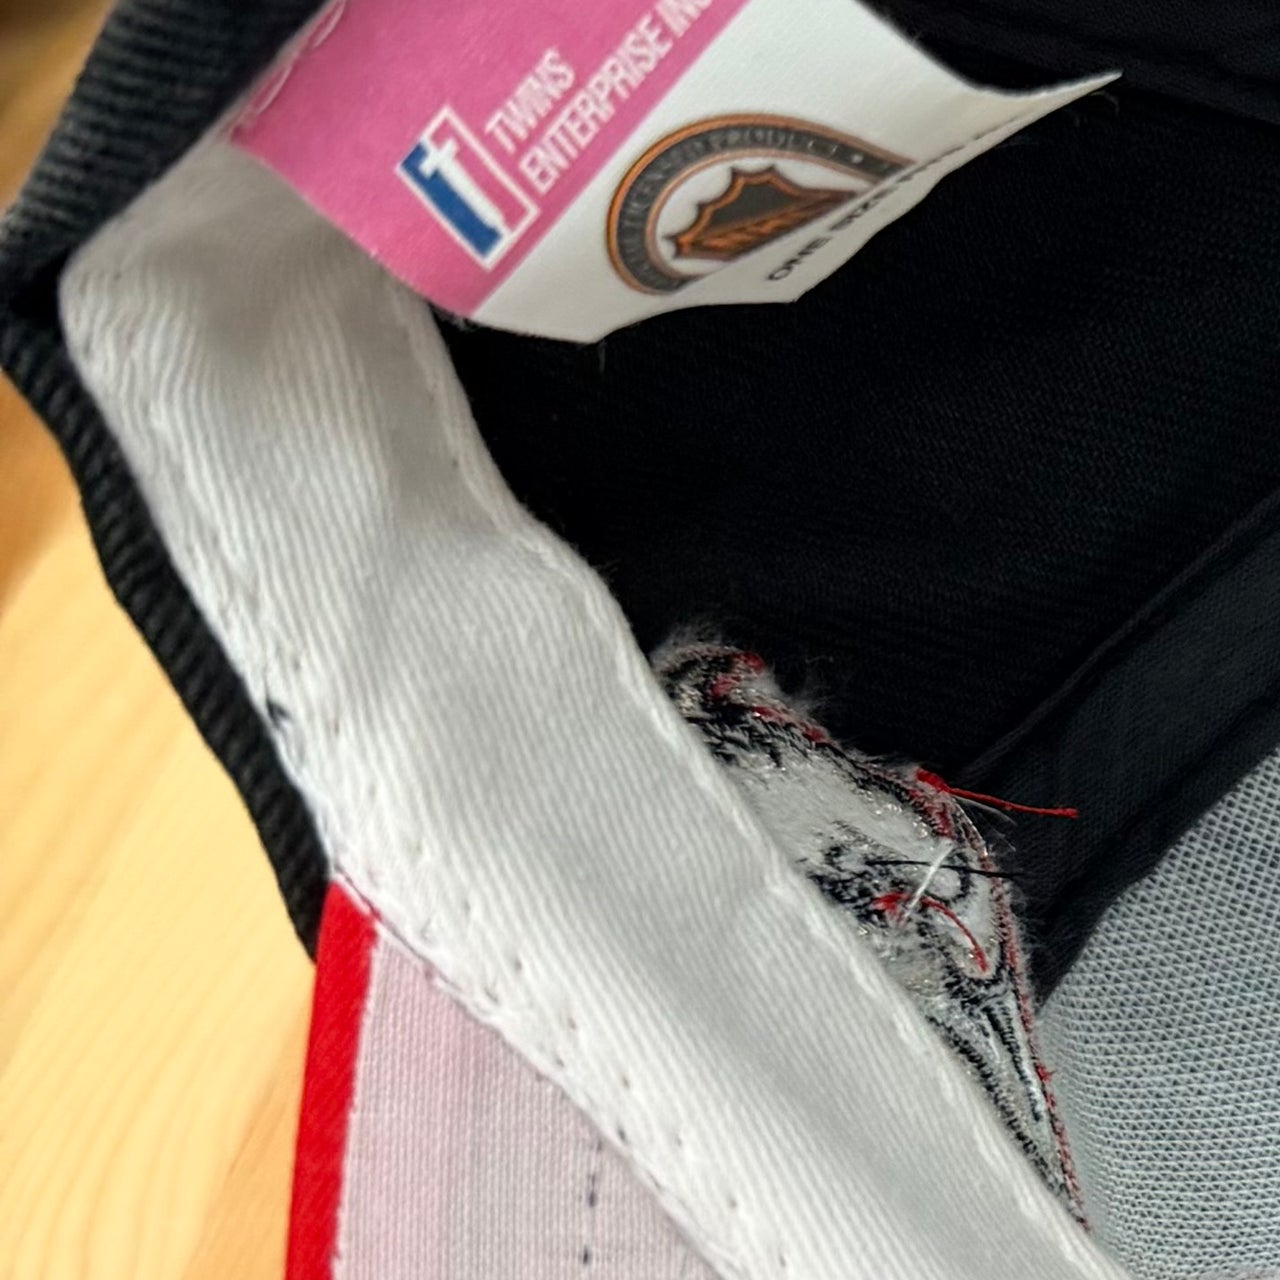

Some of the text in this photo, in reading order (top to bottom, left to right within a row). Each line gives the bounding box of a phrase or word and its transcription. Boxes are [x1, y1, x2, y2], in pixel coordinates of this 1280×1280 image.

[485, 45, 576, 154] TWINS
[518, 13, 674, 196] ENTERPRISE
[765, 234, 831, 282] ONE
